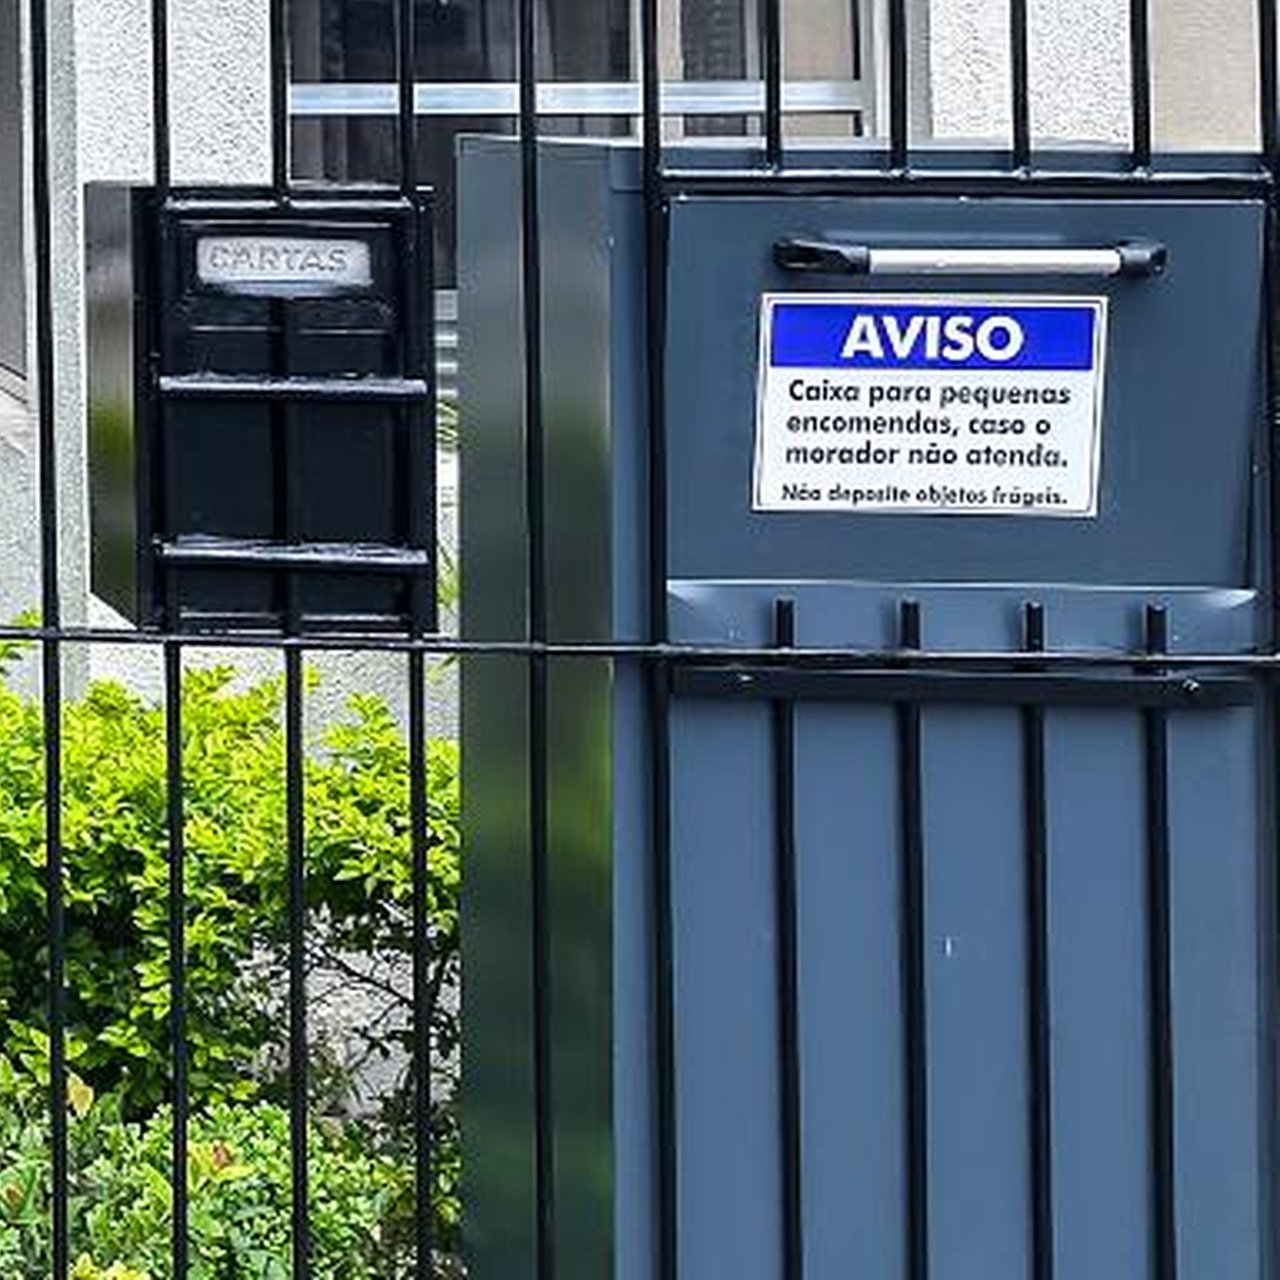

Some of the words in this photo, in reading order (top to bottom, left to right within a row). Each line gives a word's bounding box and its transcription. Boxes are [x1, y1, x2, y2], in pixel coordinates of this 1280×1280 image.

[209, 243, 348, 272] CARTAS
[840, 314, 1025, 363] AVISO
[788, 379, 861, 403] Caixa
[868, 385, 932, 408] para
[940, 386, 1072, 408] pequenas
[785, 410, 959, 437] encomendas,
[967, 418, 1027, 436] caso
[1035, 419, 1052, 436] o
[785, 440, 900, 466] morador
[907, 444, 958, 466] não
[965, 443, 1069, 469] atenda.
[781, 483, 822, 502] Não
[827, 484, 912, 506] deposite
[915, 484, 988, 505] objetos
